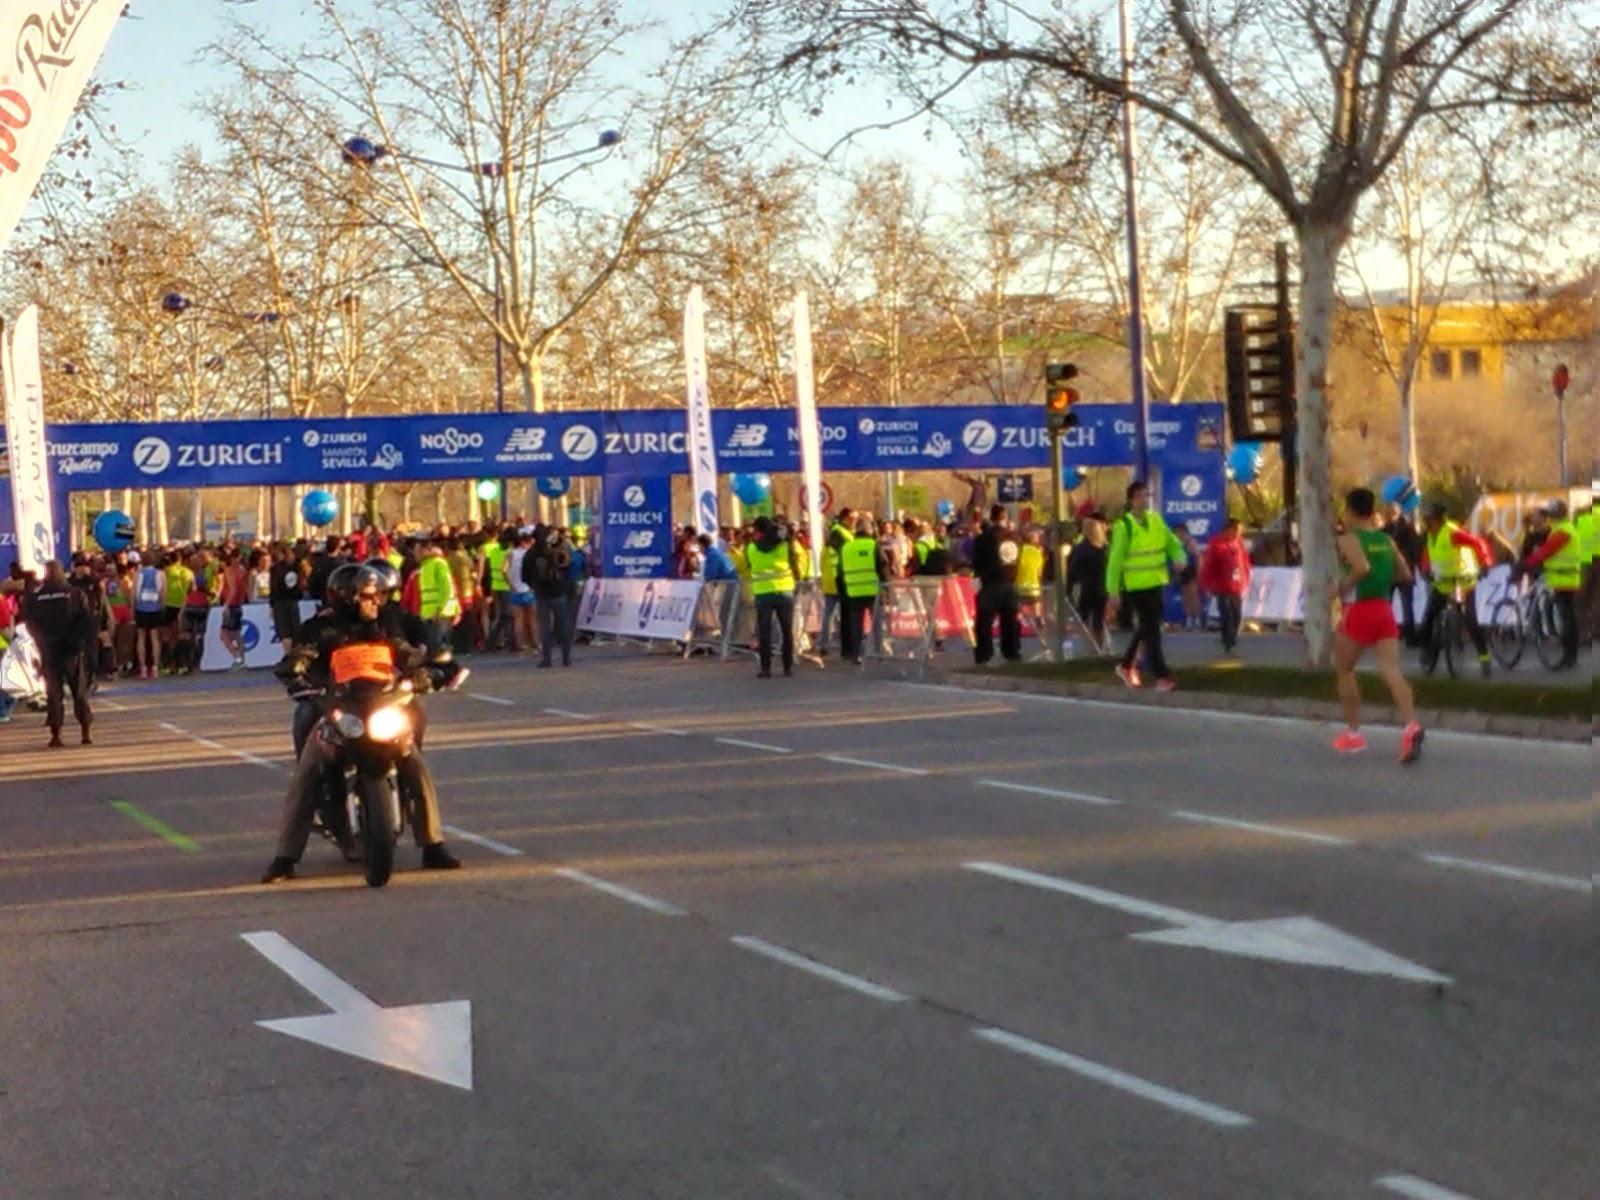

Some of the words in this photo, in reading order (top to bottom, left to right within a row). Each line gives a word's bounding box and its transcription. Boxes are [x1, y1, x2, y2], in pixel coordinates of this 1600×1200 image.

[876, 421, 919, 431] ZURICH
[322, 433, 367, 444] ZURICH
[604, 432, 690, 455] ZURIC
[1001, 427, 1095, 448] ZURCH
[177, 444, 282, 467] ZURICH
[876, 445, 919, 456] SEVILLA
[496, 453, 517, 461] new
[518, 452, 553, 462] balance
[321, 458, 368, 469] SEVILLA
[1166, 500, 1218, 514] ZURICH
[608, 512, 663, 525] ZURICH
